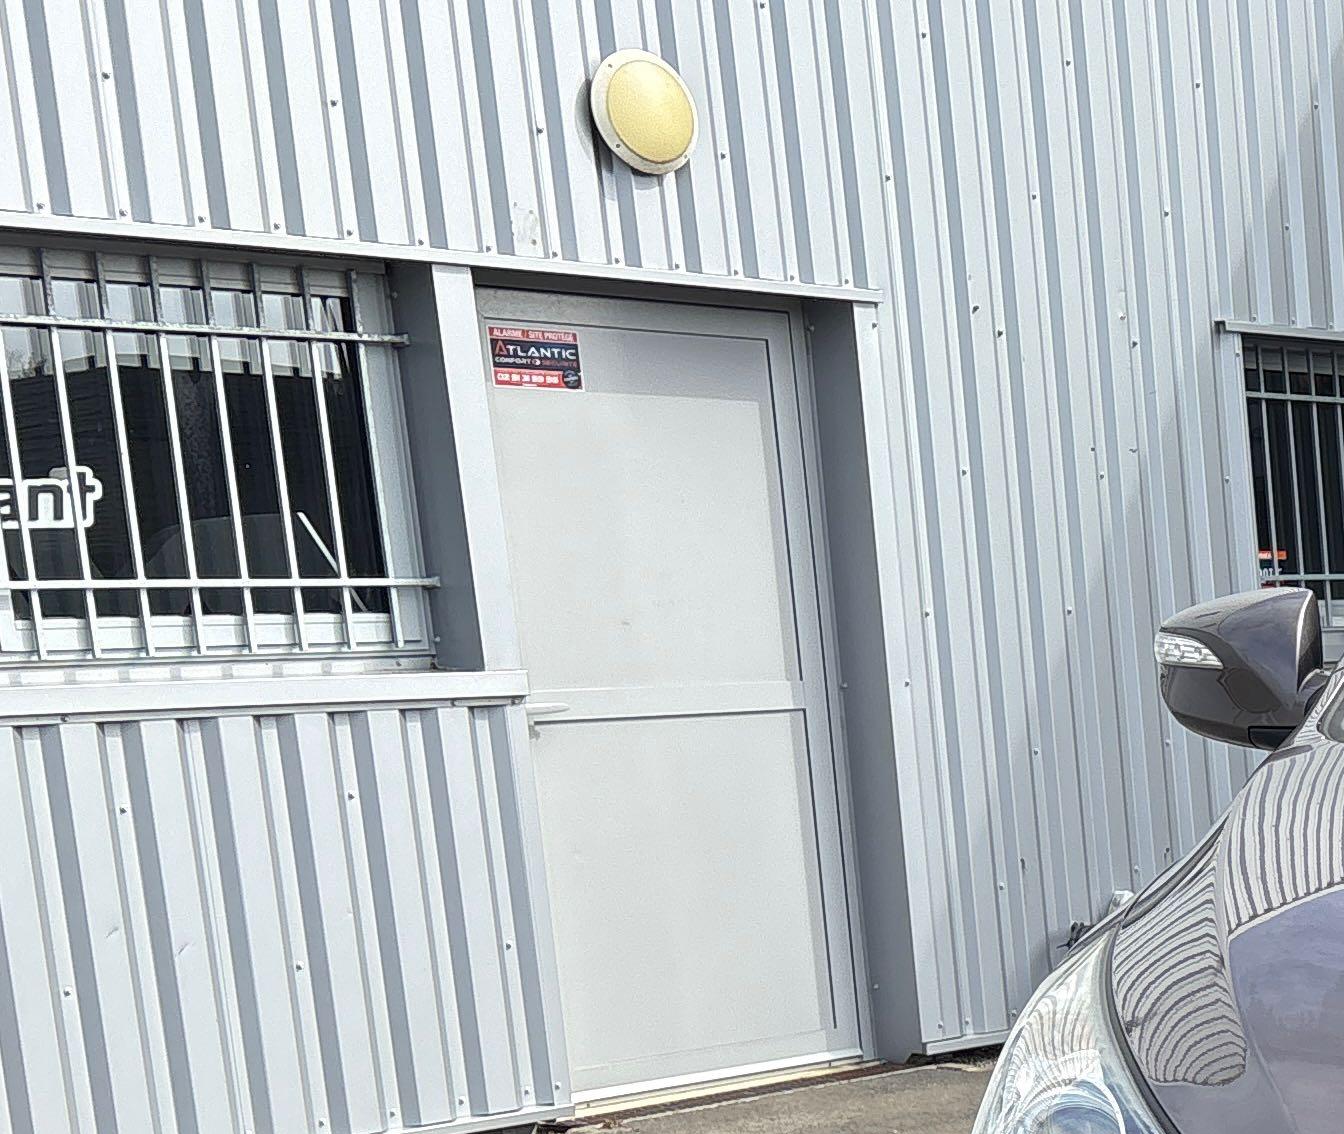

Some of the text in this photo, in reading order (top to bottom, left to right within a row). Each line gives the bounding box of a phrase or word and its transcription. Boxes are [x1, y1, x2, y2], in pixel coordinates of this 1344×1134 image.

[493, 328, 523, 337] ALARME
[528, 331, 543, 340] SITE
[495, 340, 576, 359] ATLANTIC
